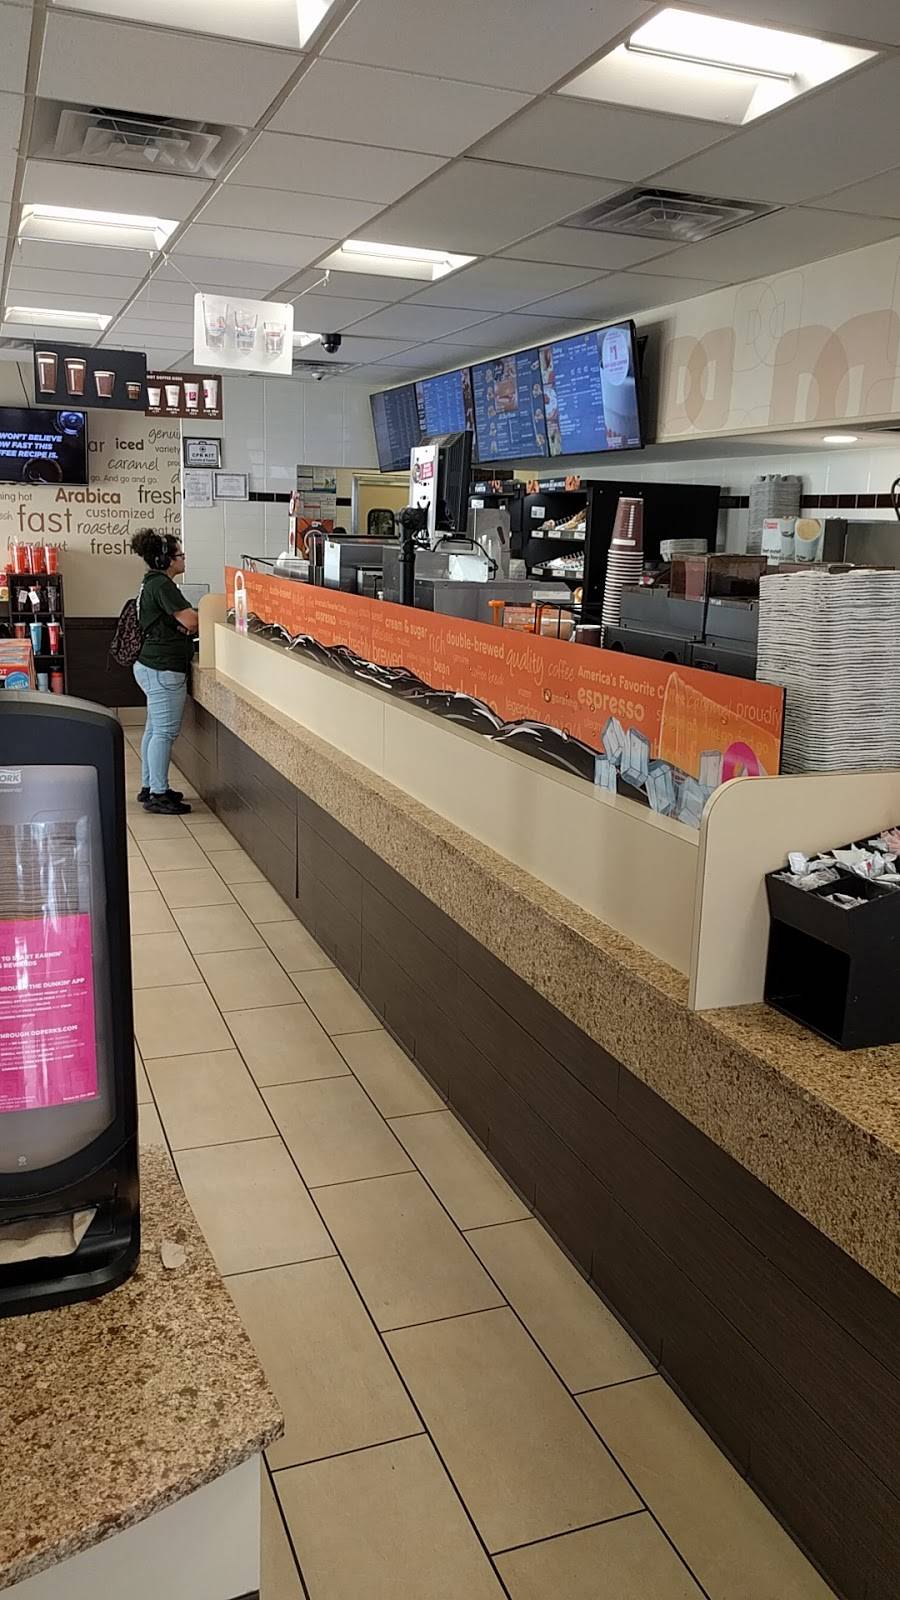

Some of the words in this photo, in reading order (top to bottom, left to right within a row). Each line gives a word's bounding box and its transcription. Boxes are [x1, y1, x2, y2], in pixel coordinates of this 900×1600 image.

[28, 434, 62, 442] BELIEVE
[115, 438, 144, 450] iced
[18, 450, 46, 458] RECIPE
[108, 457, 159, 471] caramel
[18, 492, 32, 500] hot
[55, 488, 120, 504] Arabica
[138, 485, 182, 504] fresh
[17, 504, 72, 533] fast
[86, 508, 154, 519] customized
[77, 520, 130, 536] roasted
[90, 538, 133, 554] fresh
[433, 655, 450, 676] bean
[446, 630, 505, 660] double-brewed
[506, 647, 544, 687] quality
[548, 658, 575, 683] coffee
[577, 665, 617, 688] America's
[618, 675, 656, 698] Favorite
[577, 686, 646, 722] espresso
[42, 980, 70, 988] DUNKIN'
[72, 977, 86, 985] APP
